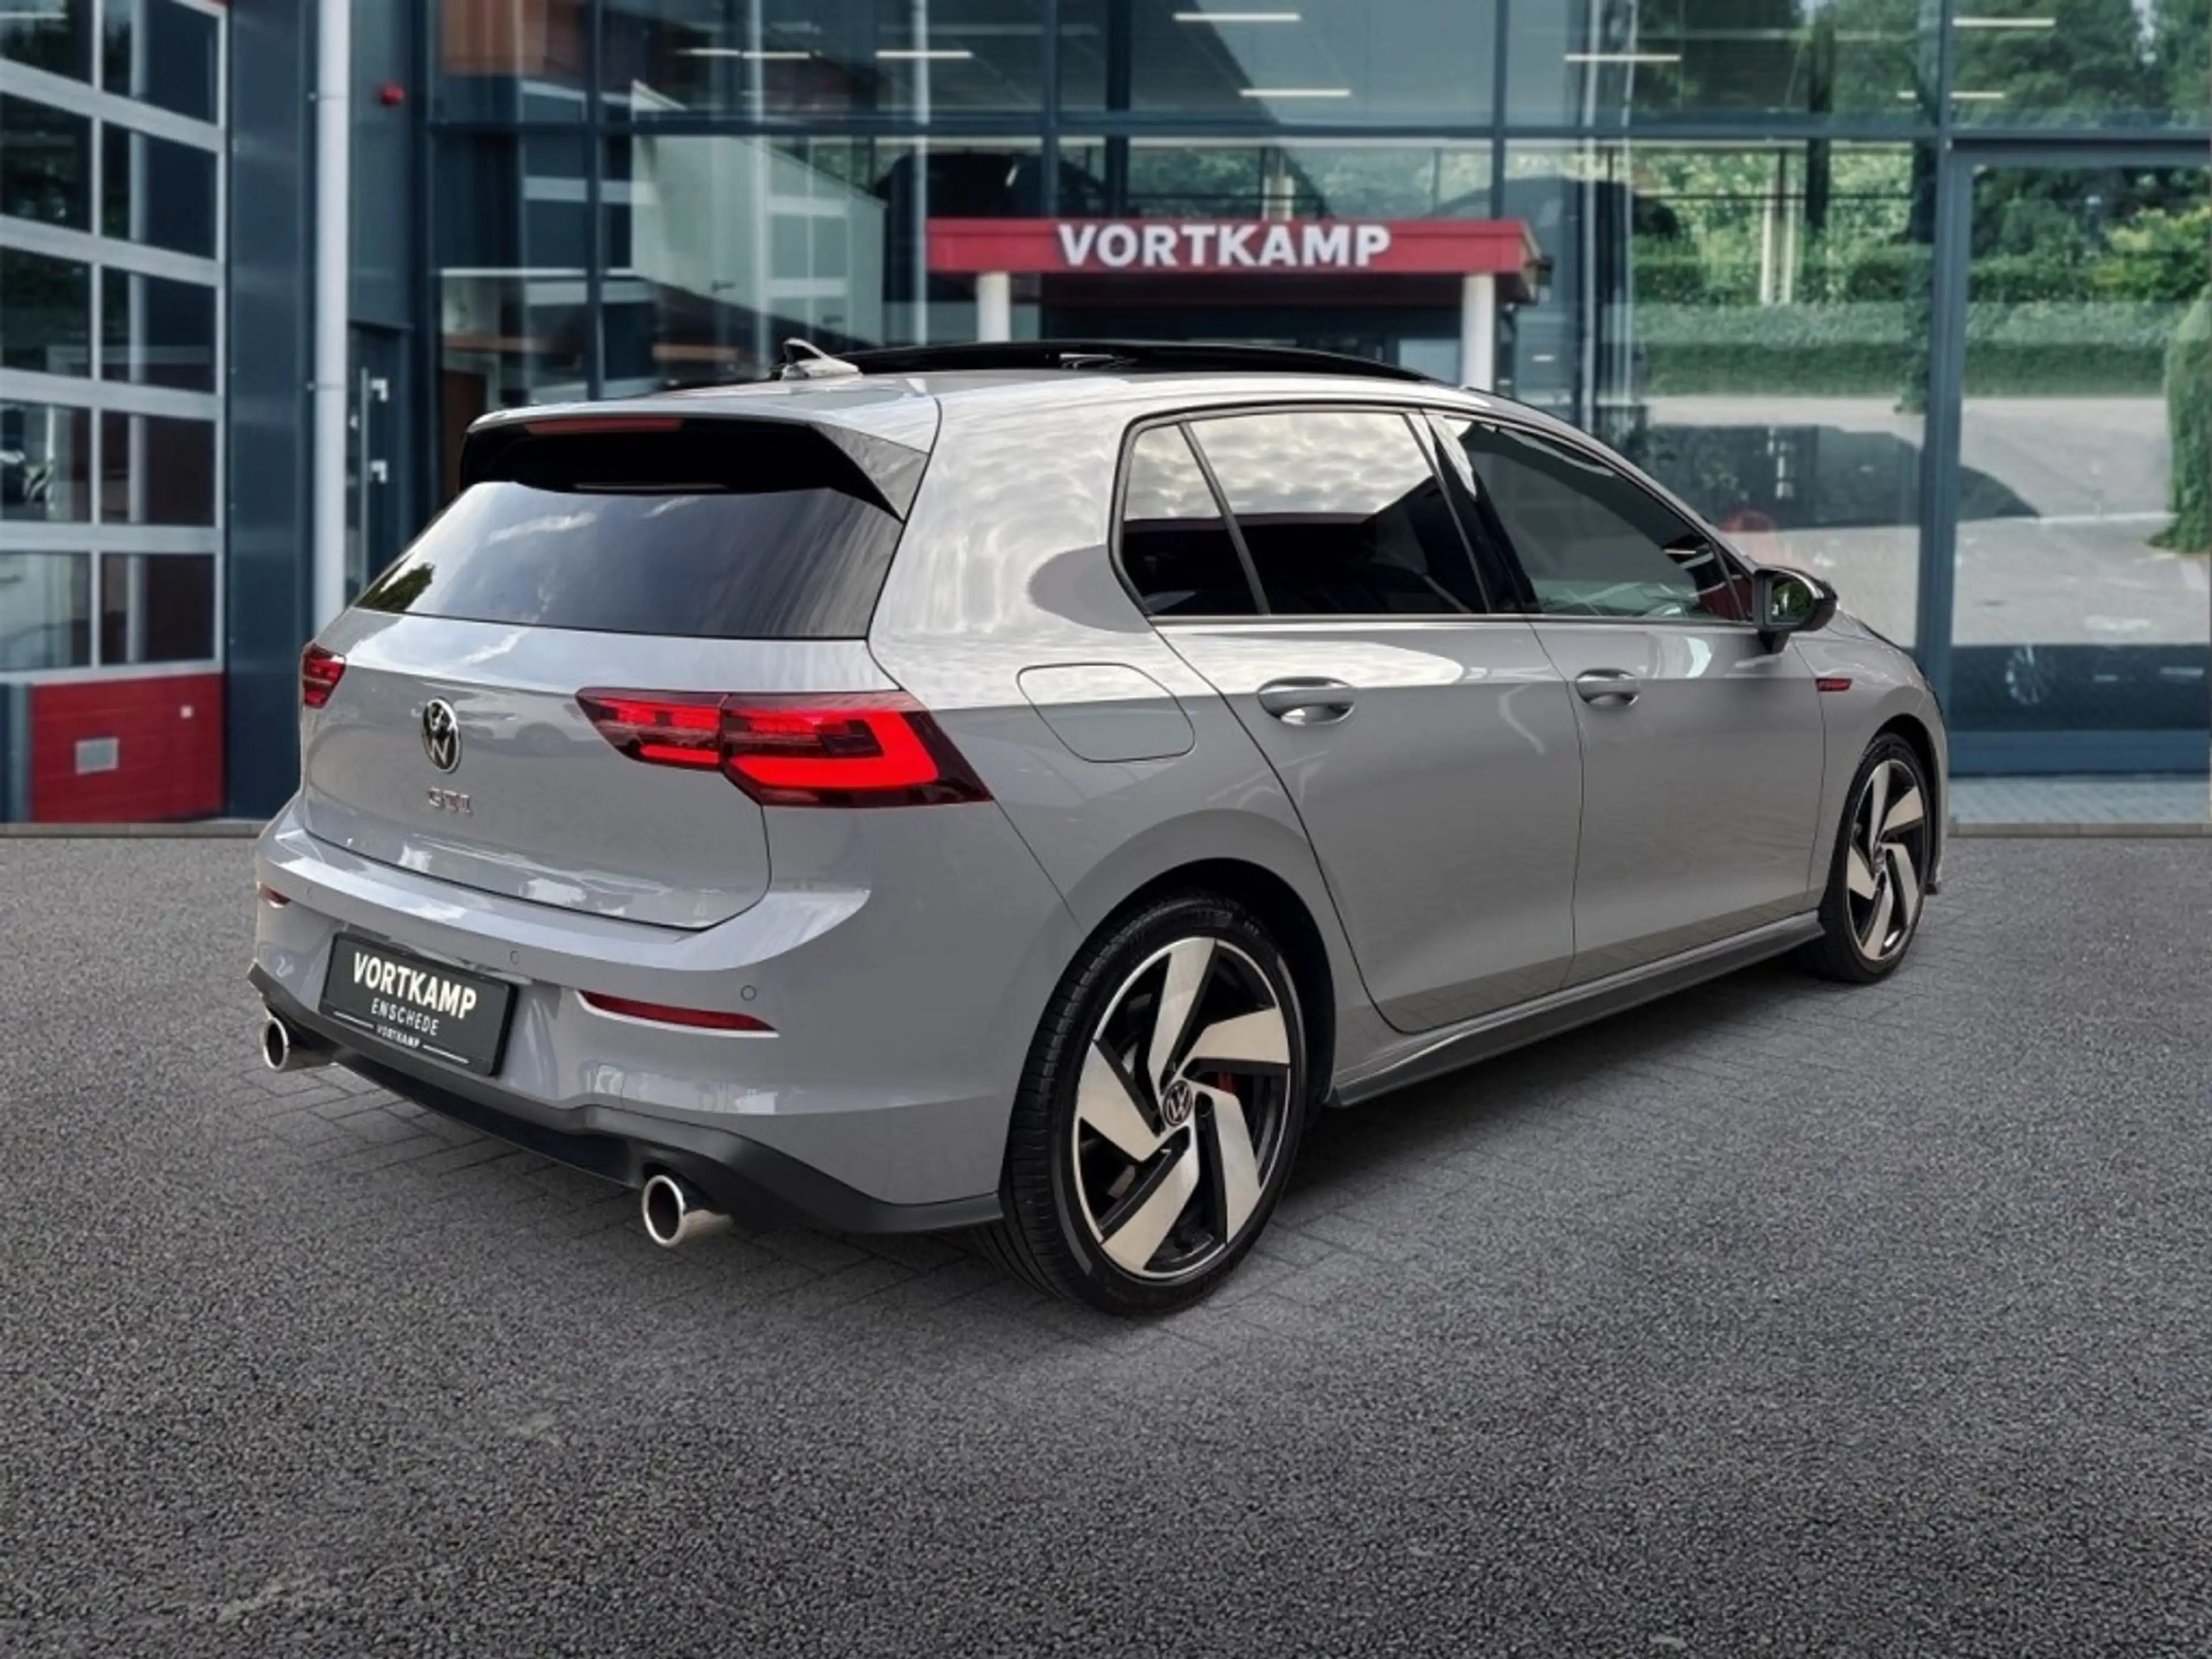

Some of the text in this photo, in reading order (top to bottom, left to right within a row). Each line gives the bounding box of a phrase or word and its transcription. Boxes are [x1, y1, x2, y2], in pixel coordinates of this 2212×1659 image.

[1058, 224, 1391, 267] VORTKAMP
[353, 952, 477, 1019] VORTKAMP
[372, 998, 440, 1036] ENSCHEDE
